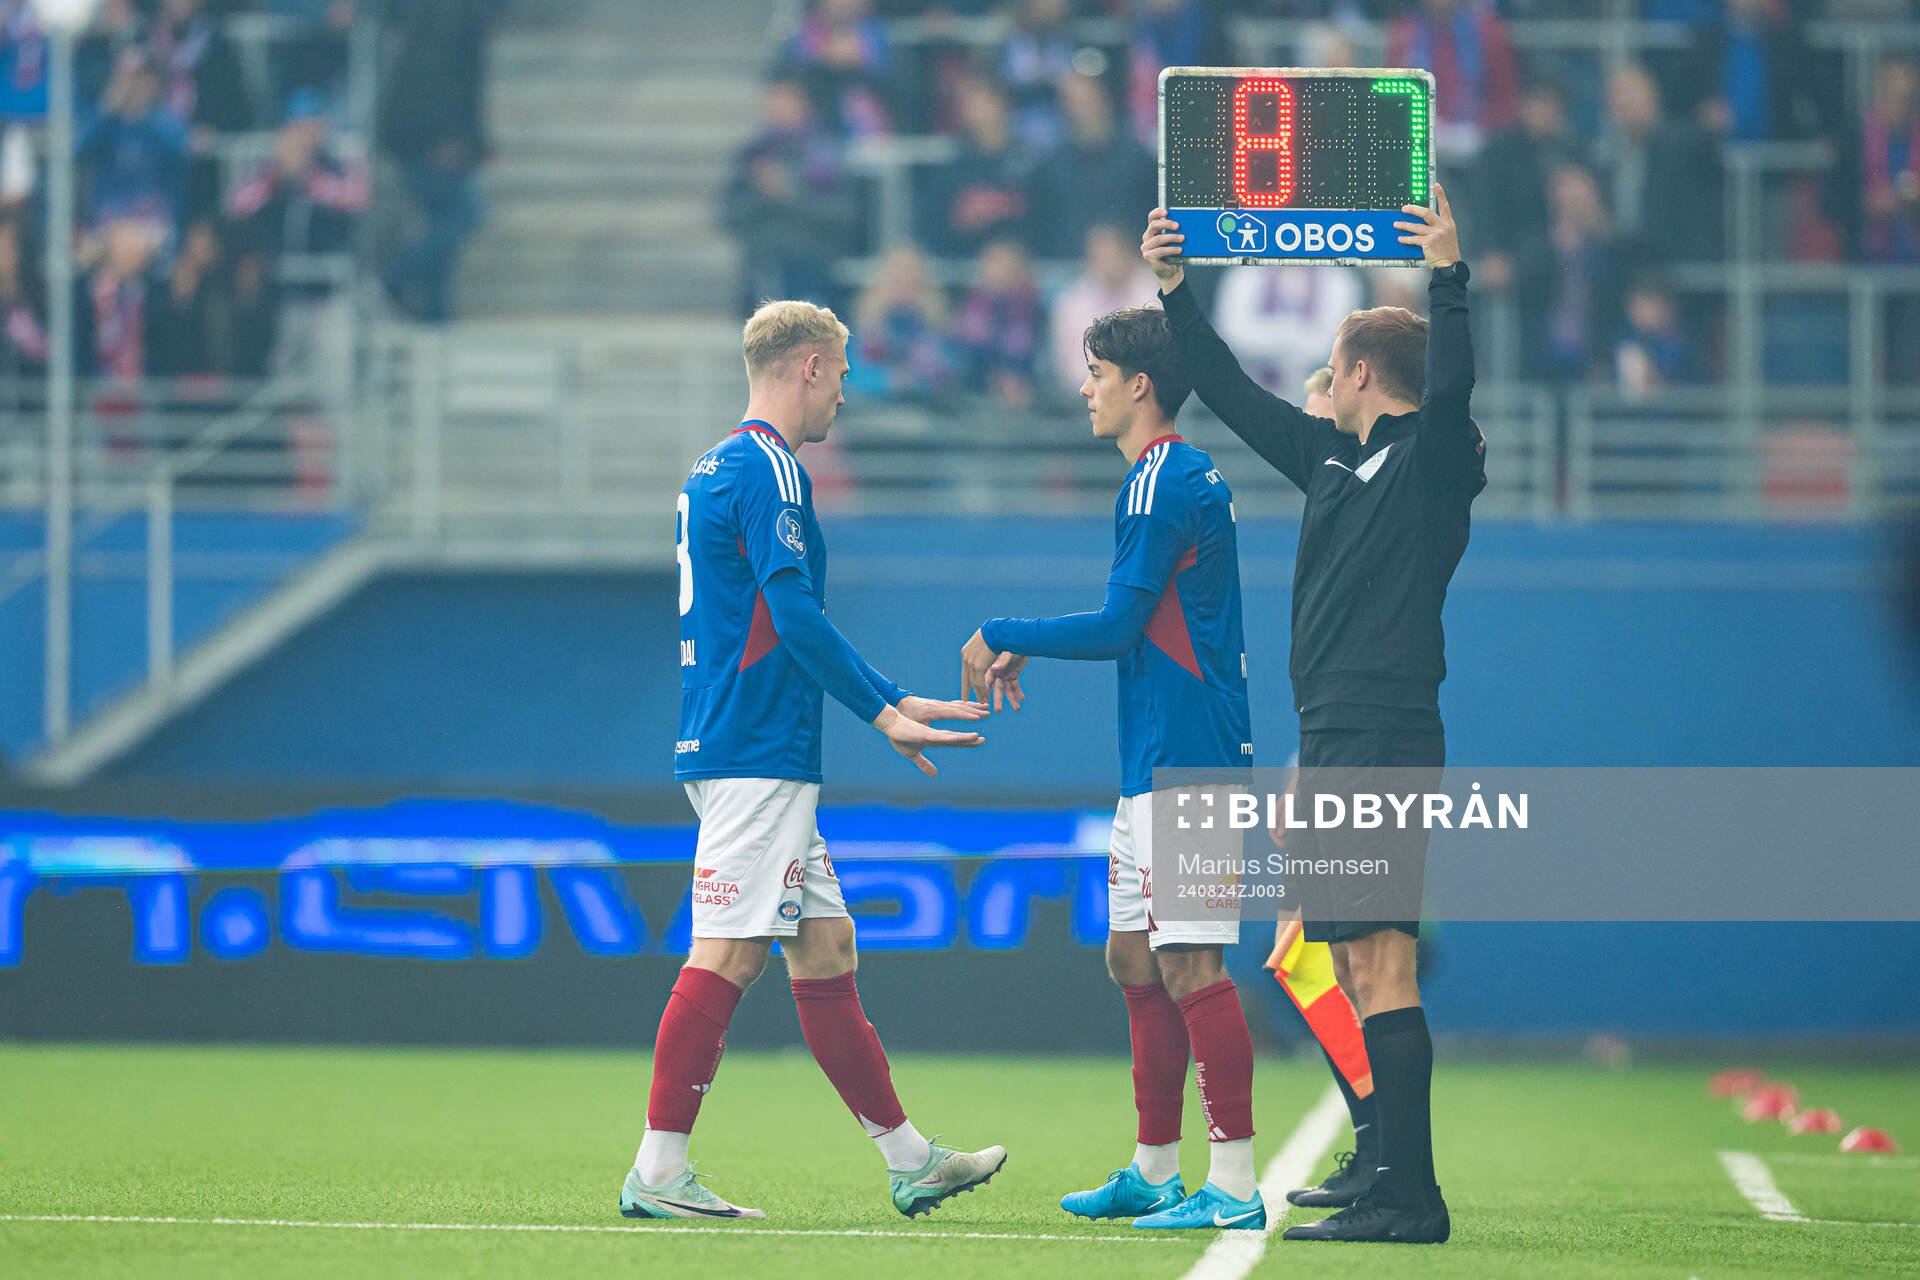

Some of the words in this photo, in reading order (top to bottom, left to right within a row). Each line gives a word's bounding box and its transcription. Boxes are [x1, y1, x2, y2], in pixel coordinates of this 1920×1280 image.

[1234, 80, 1294, 207] 8
[1370, 76, 1427, 205] 7
[1275, 222, 1375, 252] OBOS
[692, 892, 731, 906] GLASS
[1205, 898, 1241, 910] CARG
